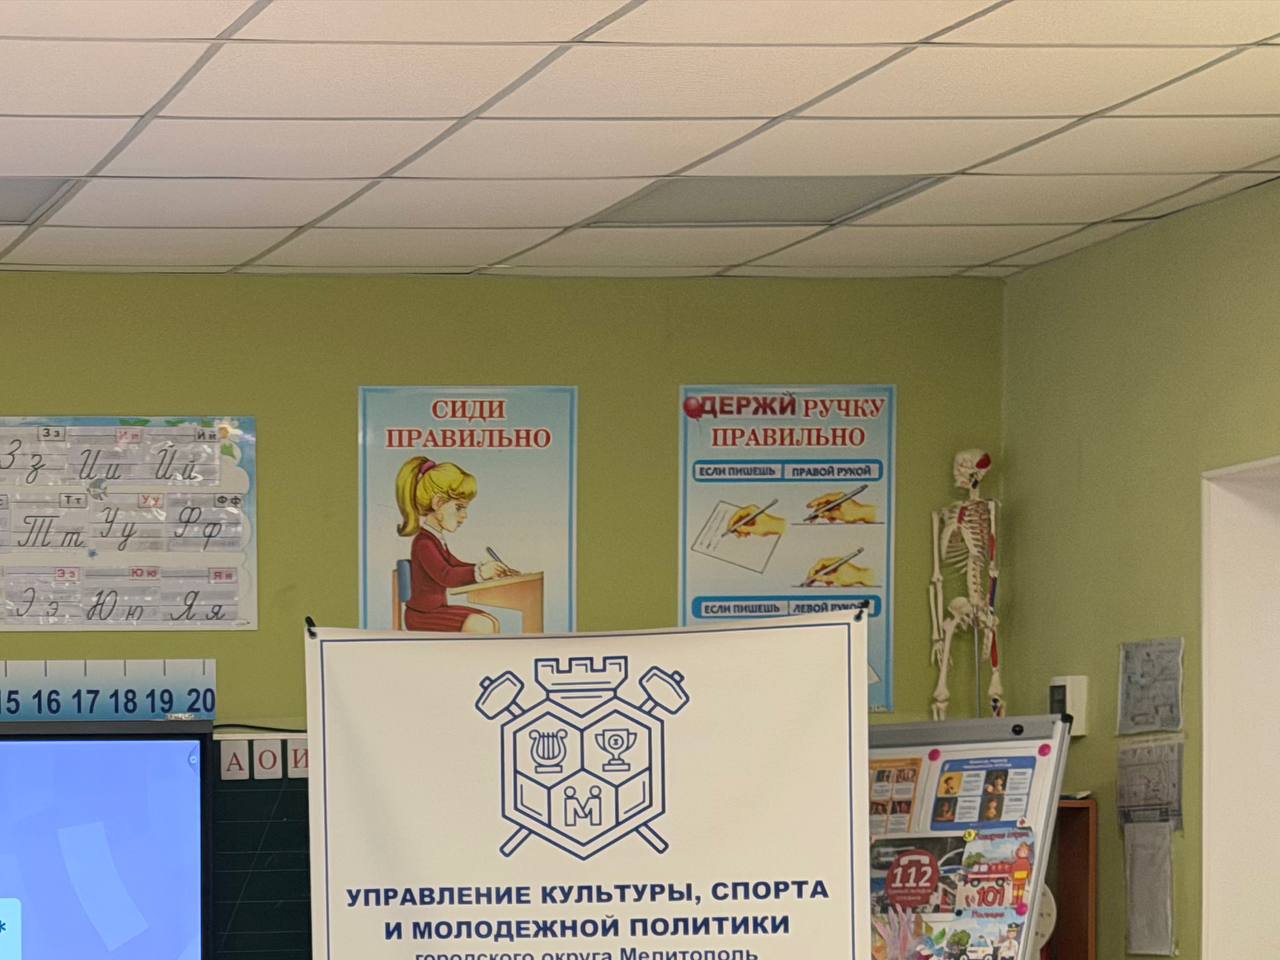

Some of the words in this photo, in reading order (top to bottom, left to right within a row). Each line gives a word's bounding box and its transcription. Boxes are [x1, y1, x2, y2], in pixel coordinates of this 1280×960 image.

[432, 400, 505, 422] СИДИ
[803, 398, 885, 418] РУЧКУ
[386, 427, 551, 449] ПРАВИЛЬНО
[712, 428, 865, 447] ПРАВИЛЬНО
[699, 467, 727, 477] ЕСЛИ
[728, 466, 776, 476] ПИШЕШЬ
[792, 466, 835, 477] ПРАВОЙ
[837, 465, 872, 476] РУКОЙ
[704, 603, 732, 615] ЕСЛИ
[733, 603, 780, 614] ПИШЕШЬ
[793, 601, 829, 614] ЛЕВОЙ
[32, 690, 61, 715] 16
[72, 689, 100, 714] 17
[109, 689, 138, 714] 18
[145, 689, 174, 714] 19
[186, 688, 216, 713] 20
[226, 752, 244, 772] А
[258, 749, 277, 770] О
[891, 866, 933, 888] 112
[346, 885, 531, 908] УПРАВЛЕНИЕ
[541, 883, 702, 907] КУЛЬТУРЫ,
[711, 880, 829, 900] СПОРТА
[976, 886, 1005, 907] 101
[384, 921, 403, 941] И
[412, 914, 619, 942] МОЛОДЕЖНОЙ
[630, 915, 790, 938] ПОЛИТИКИ
